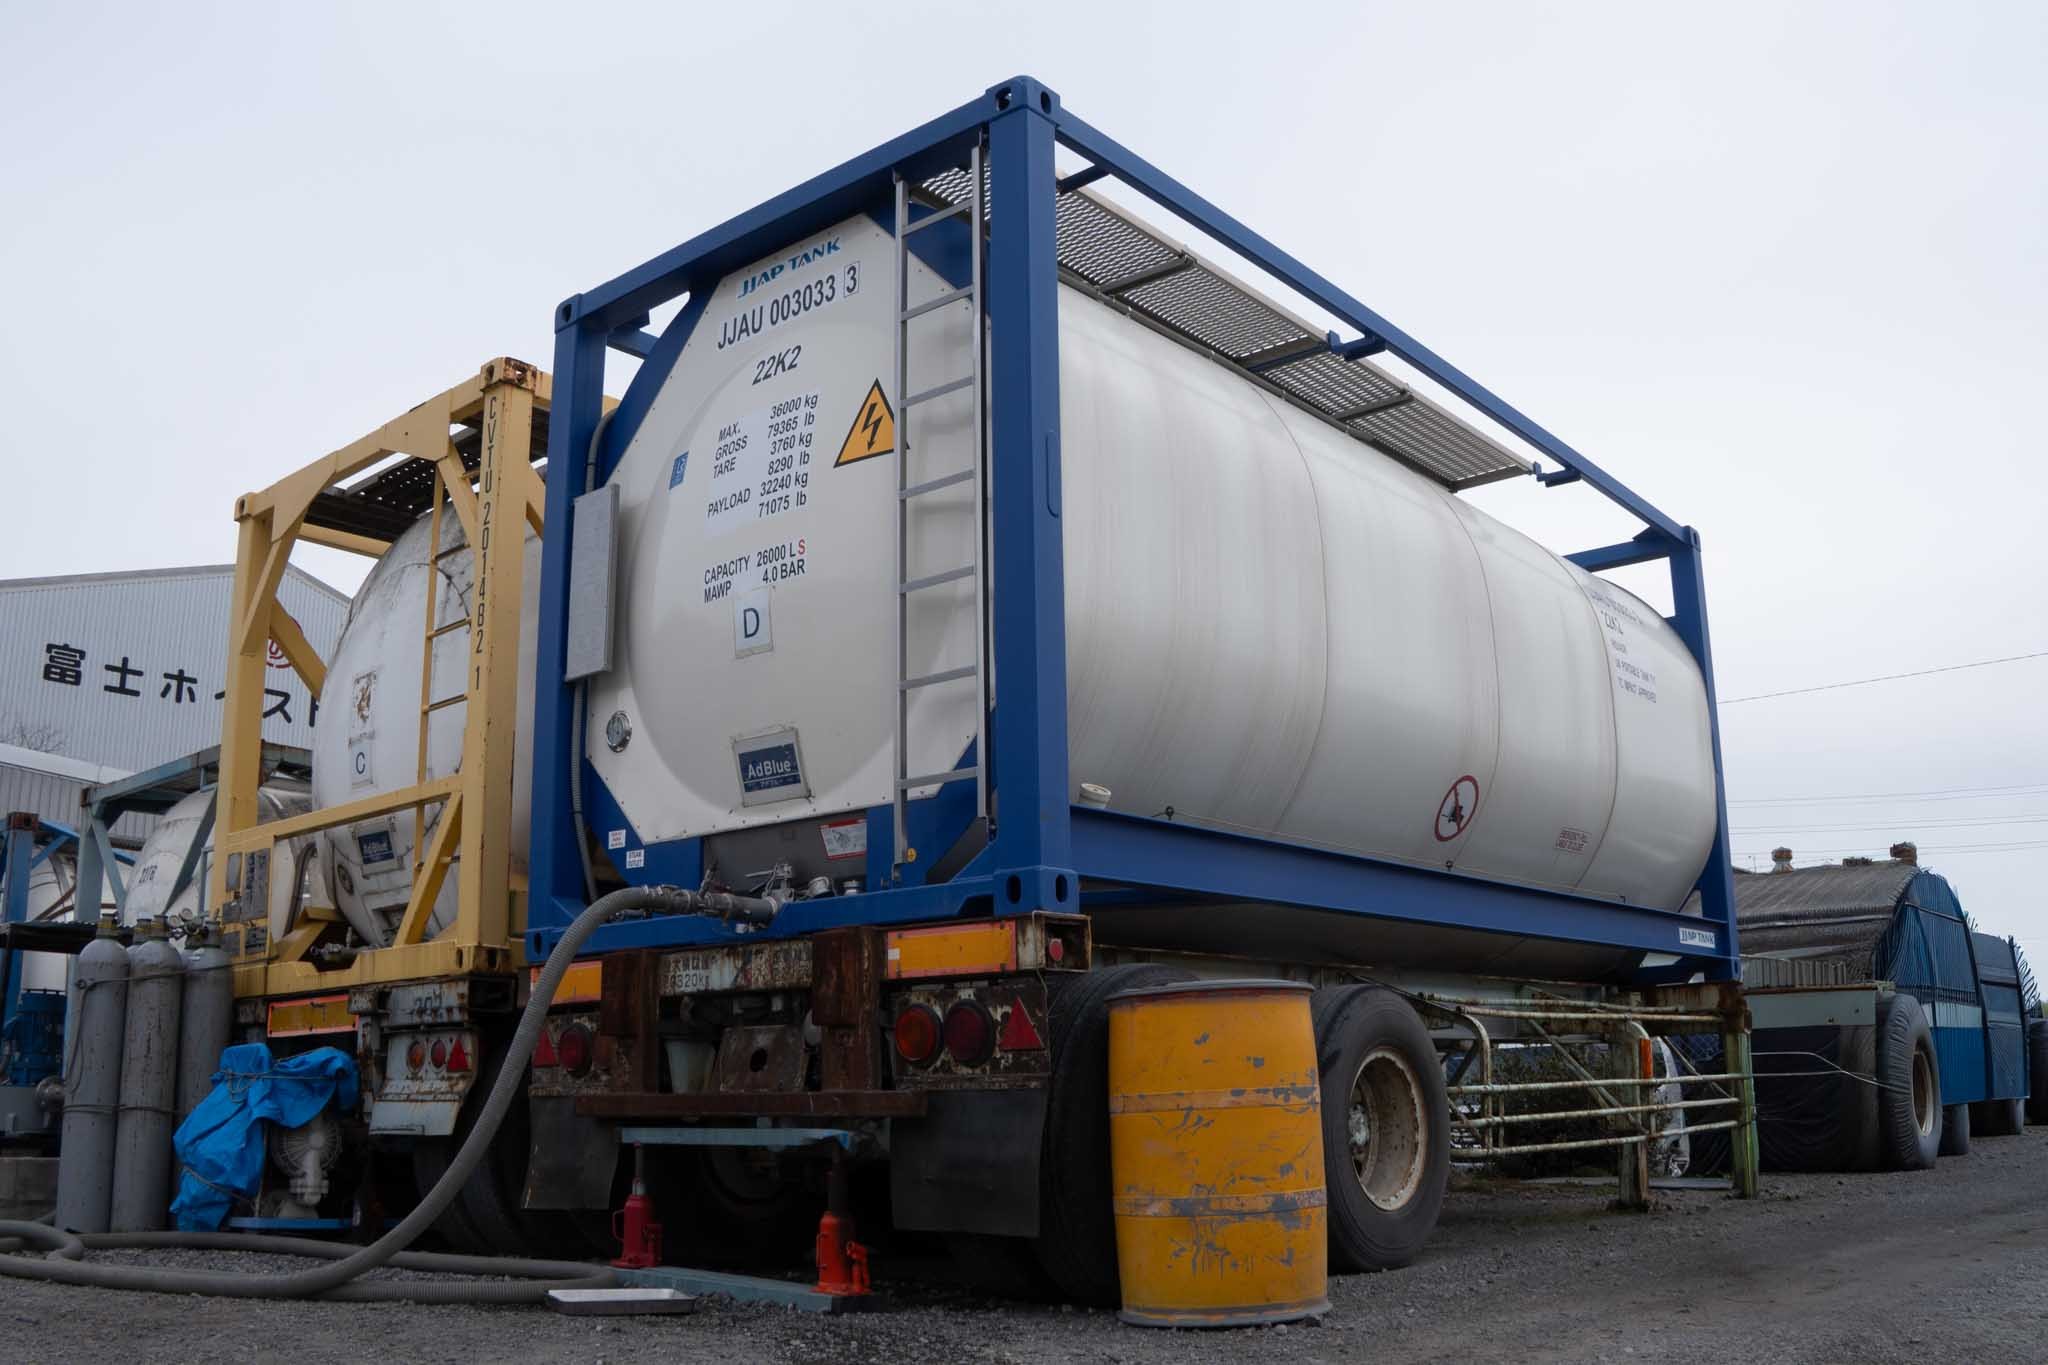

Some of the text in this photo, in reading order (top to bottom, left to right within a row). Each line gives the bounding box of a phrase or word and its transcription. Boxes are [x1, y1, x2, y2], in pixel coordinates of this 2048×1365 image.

[789, 236, 841, 270] TANK
[717, 264, 858, 350] JJAU 003033 3
[752, 345, 803, 387] 22K2
[714, 411, 815, 461] GROSS 79365 lb
[718, 393, 819, 443] MAX. 36000 kg
[484, 396, 498, 494] CVTU
[713, 431, 813, 480] TARE 3760 kg
[767, 450, 810, 476] 8290 lb
[706, 471, 809, 519] PAYLOAD 32240 kg
[758, 491, 807, 518] 71075 lb
[704, 554, 751, 585] CAPACITY
[756, 544, 786, 568] 26000
[704, 558, 806, 604] MAWP 4.0 BAR
[743, 607, 760, 639] D
[355, 751, 366, 775] C
[747, 759, 792, 780] AdBlue
